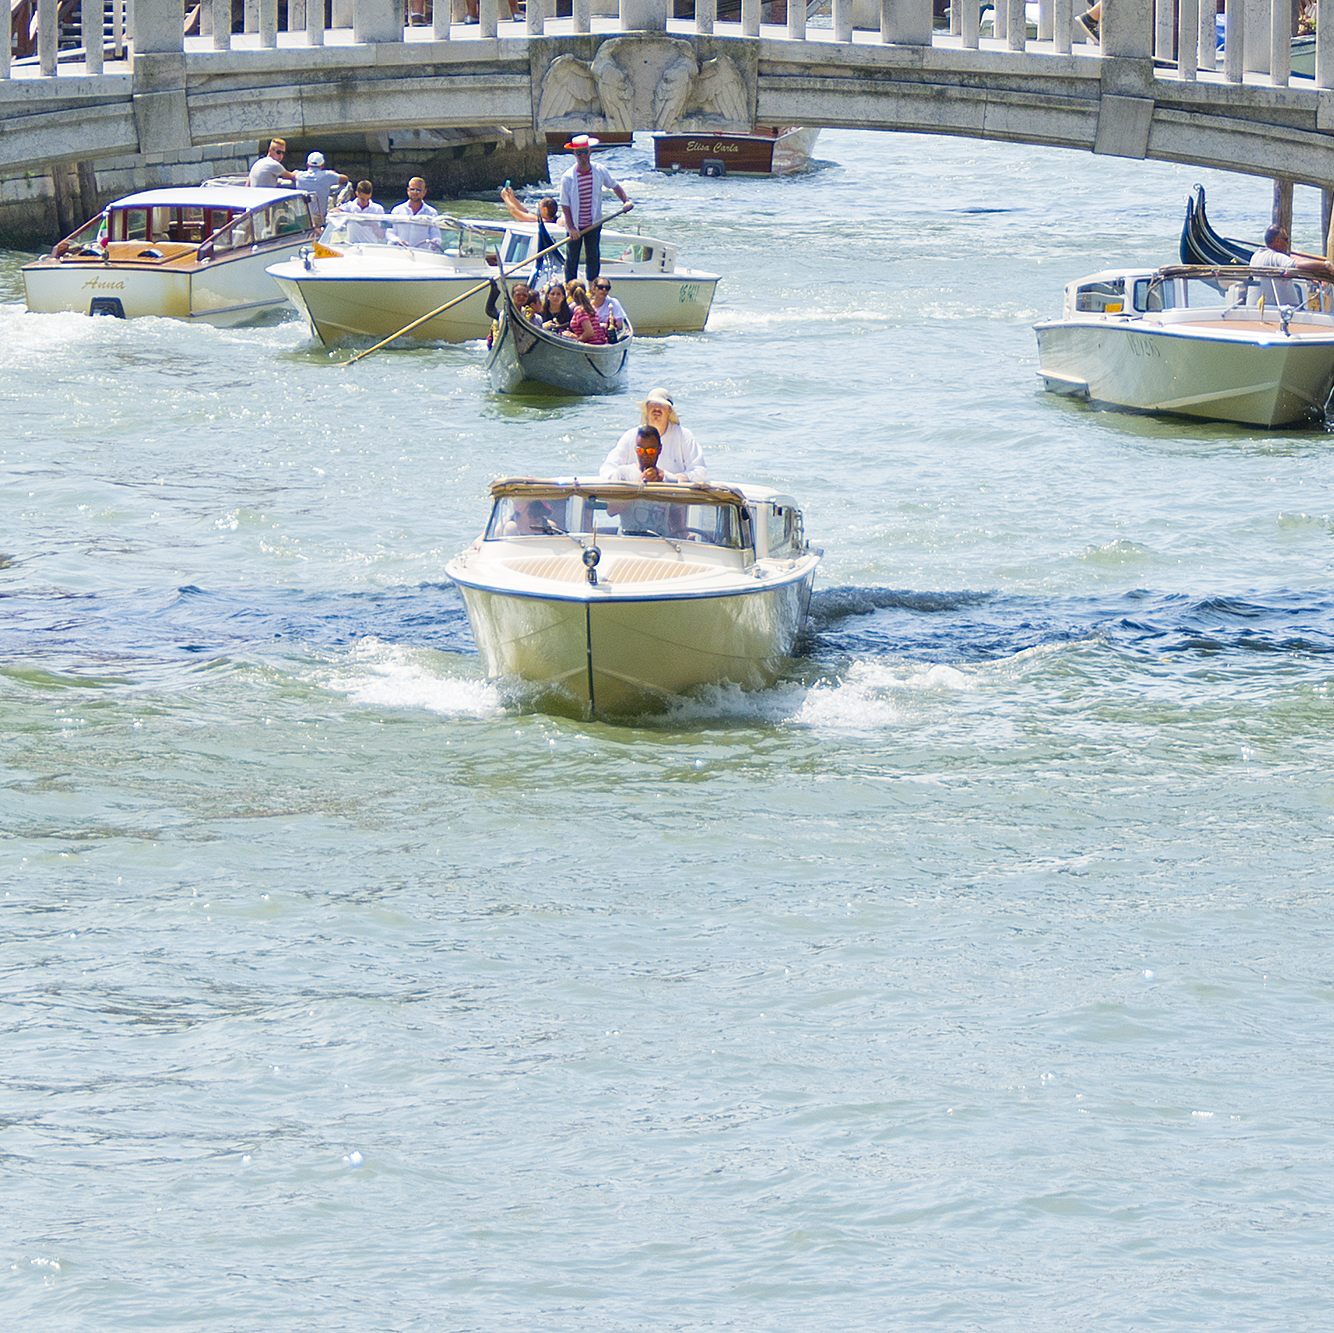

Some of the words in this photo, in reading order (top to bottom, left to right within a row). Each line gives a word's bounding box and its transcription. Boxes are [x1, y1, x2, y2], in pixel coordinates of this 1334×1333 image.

[686, 140, 709, 152] Elisa
[712, 141, 739, 154] Carla
[81, 275, 126, 290] Anna
